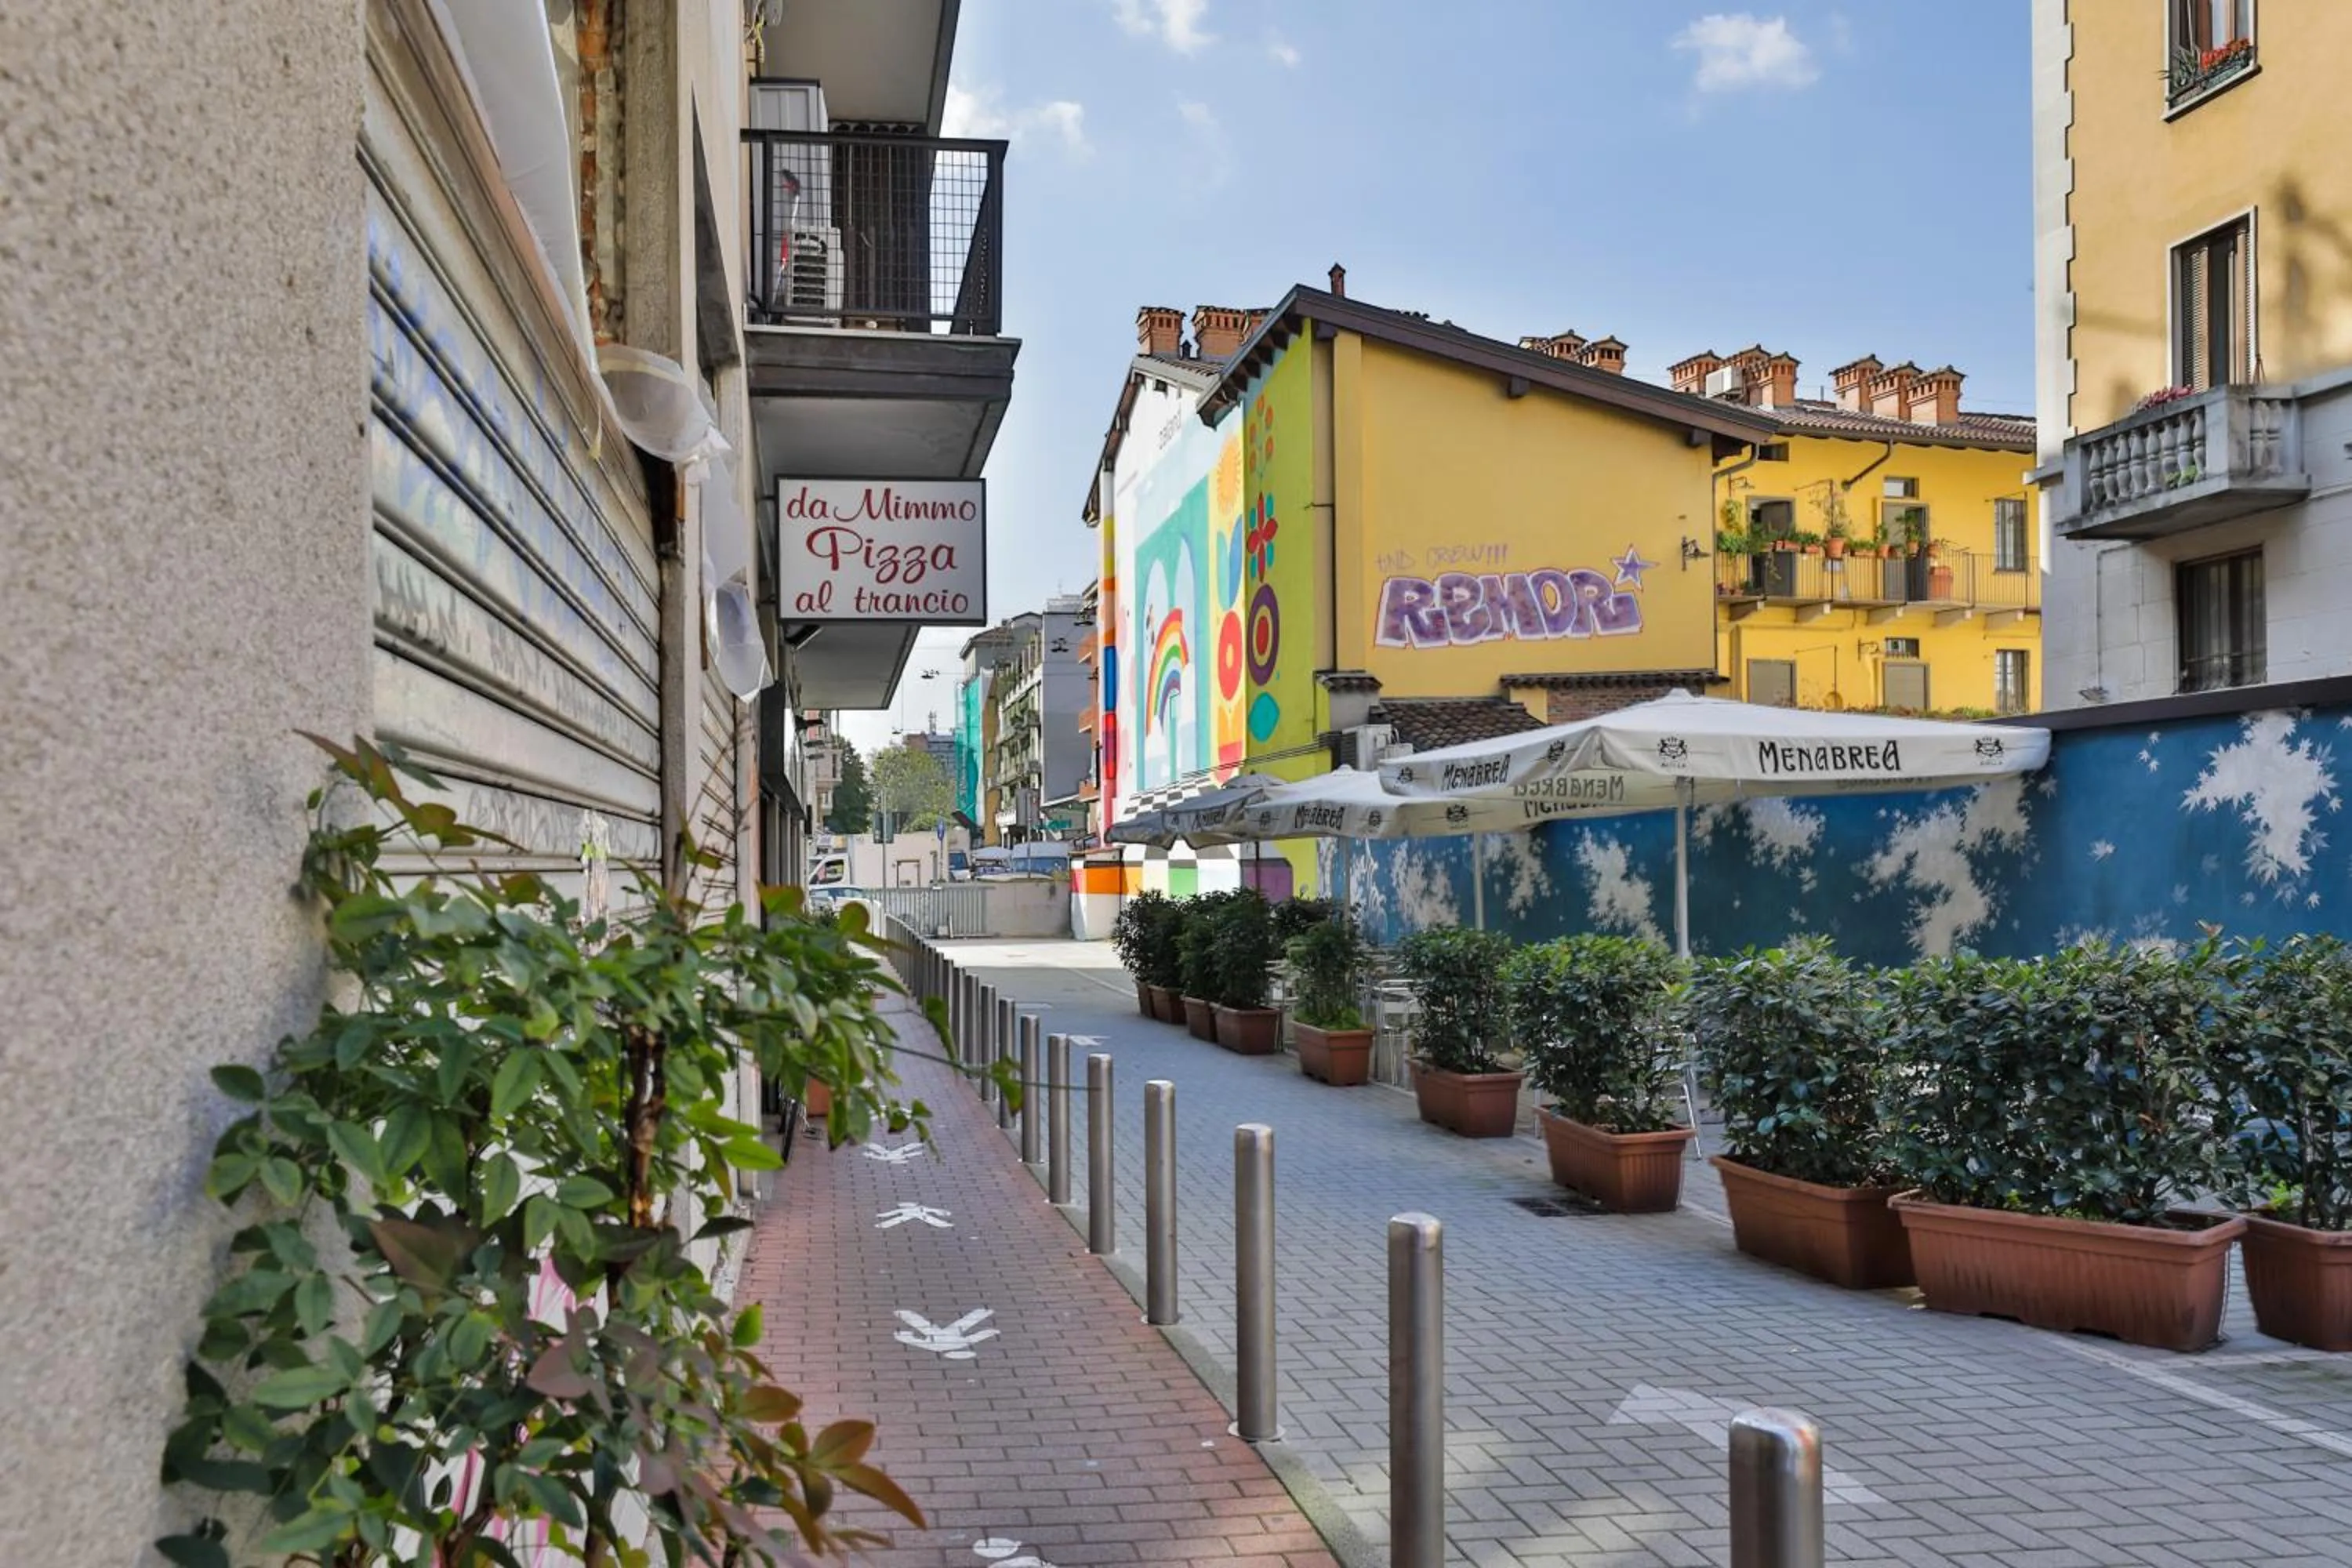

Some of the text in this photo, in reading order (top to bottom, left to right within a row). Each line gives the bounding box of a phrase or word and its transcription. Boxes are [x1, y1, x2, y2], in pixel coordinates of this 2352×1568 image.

[786, 486, 977, 522] da Mimmo
[805, 526, 958, 584] Pizza
[796, 580, 969, 614] al trancio
[1442, 753, 1511, 791] MENABREA
[1759, 739, 1901, 774] MENABREA
